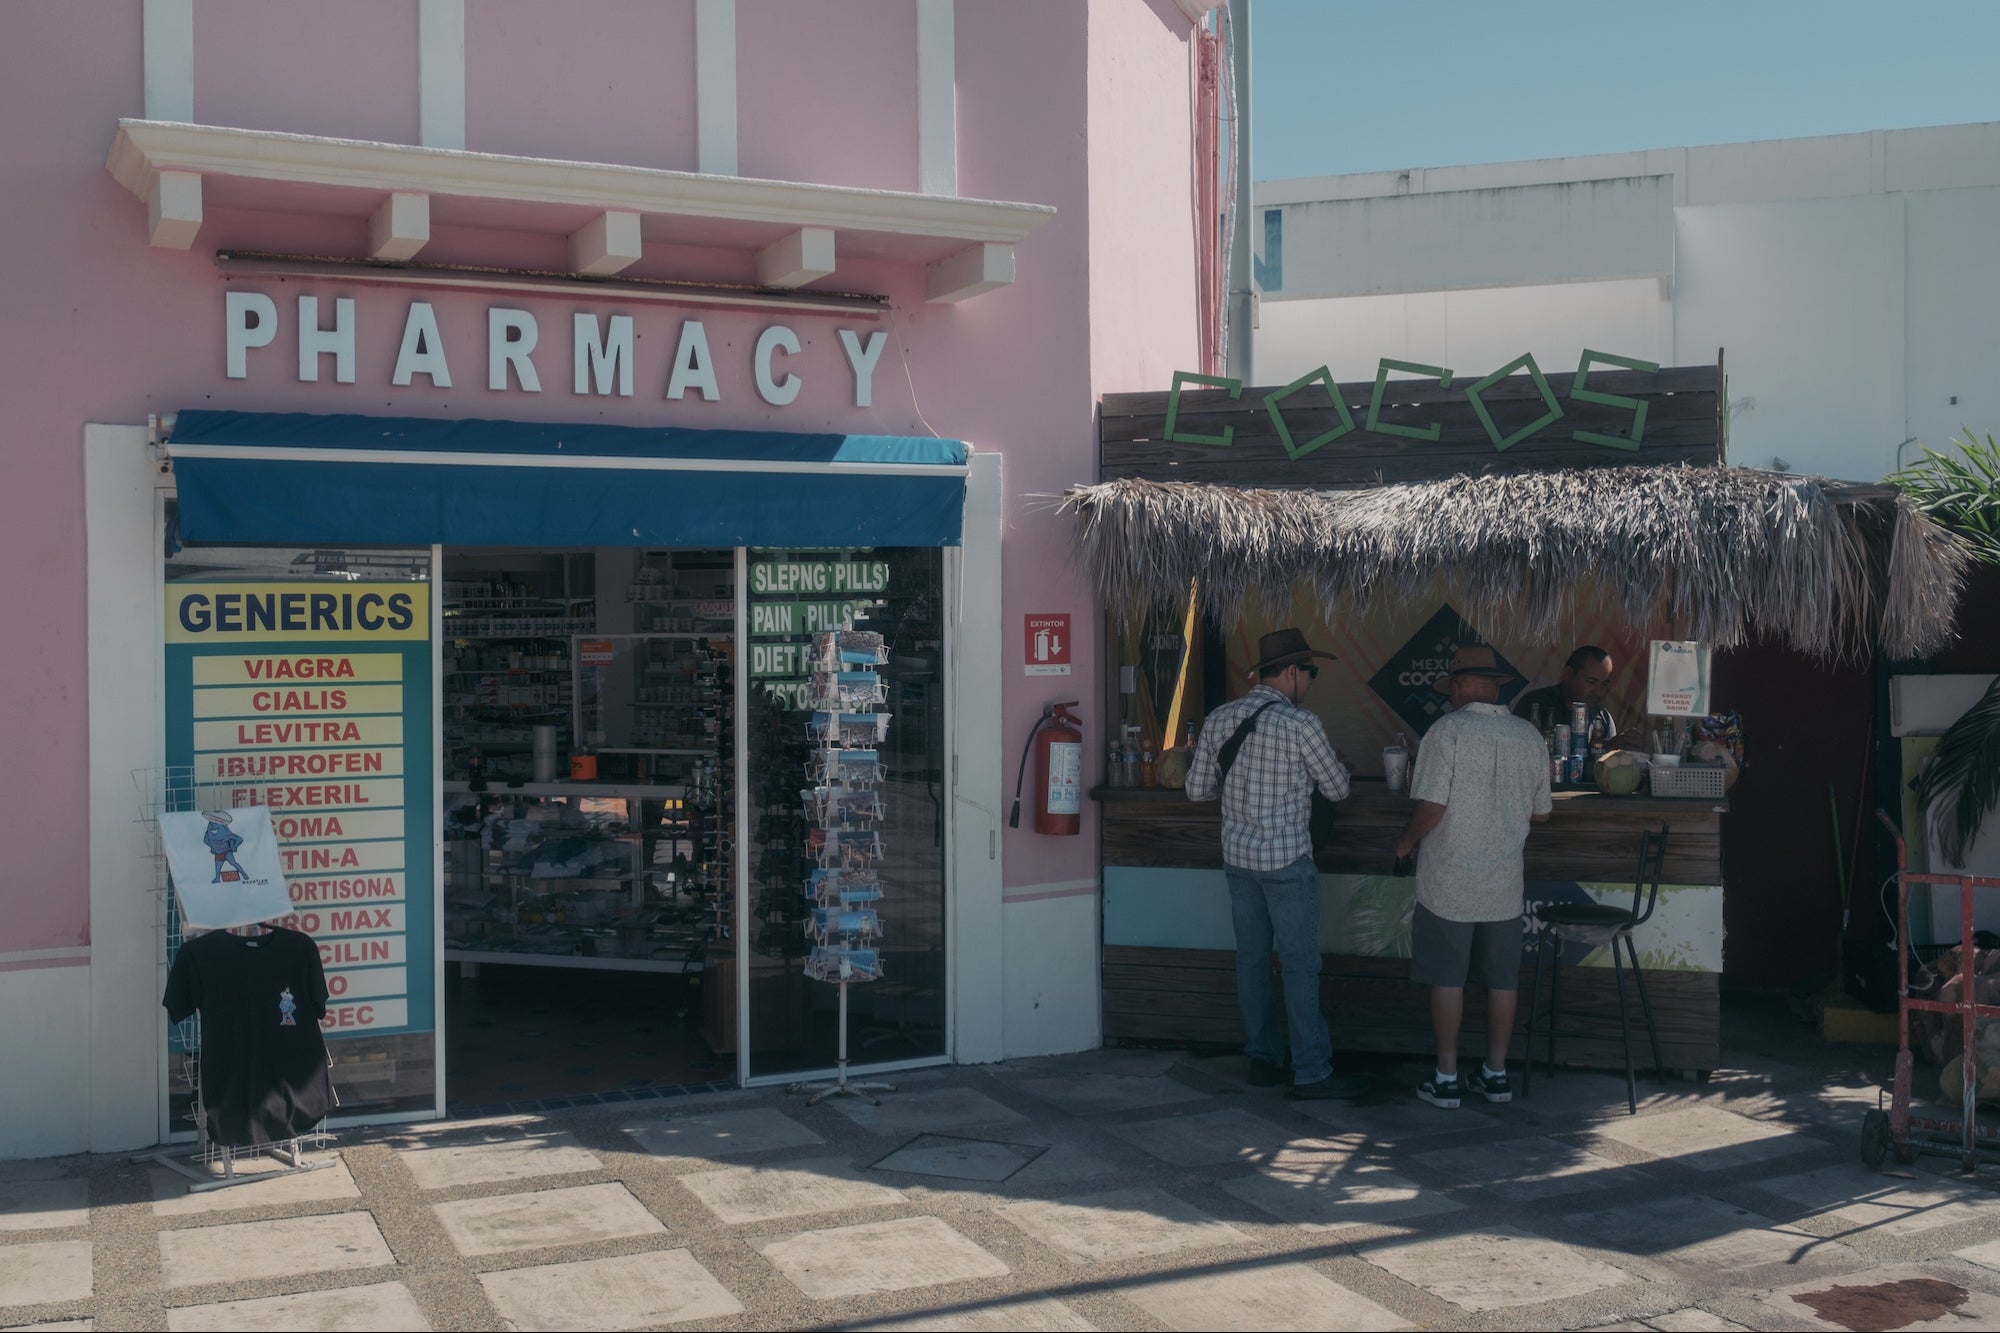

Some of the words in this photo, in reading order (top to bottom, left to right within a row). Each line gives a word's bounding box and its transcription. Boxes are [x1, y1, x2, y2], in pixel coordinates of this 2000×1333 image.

[226, 291, 888, 408] PHARMACY
[1163, 349, 1660, 461] COCOS
[755, 563, 826, 592] SLEPNG
[835, 563, 884, 590] PILLS
[179, 593, 414, 633] GENERICS
[753, 604, 792, 633] PAIN
[1030, 620, 1065, 628] EXTINTOR
[244, 658, 355, 679] VIAGRA
[753, 646, 796, 673] DIET
[252, 690, 347, 712] CIALIS
[238, 722, 361, 745] LEVITRA
[218, 753, 382, 778] IBUPROFEN
[232, 784, 369, 809] FLEXERIL
[281, 848, 359, 870] TIN-A
[288, 877, 396, 902] ORTISONA
[331, 908, 392, 932] MAX
